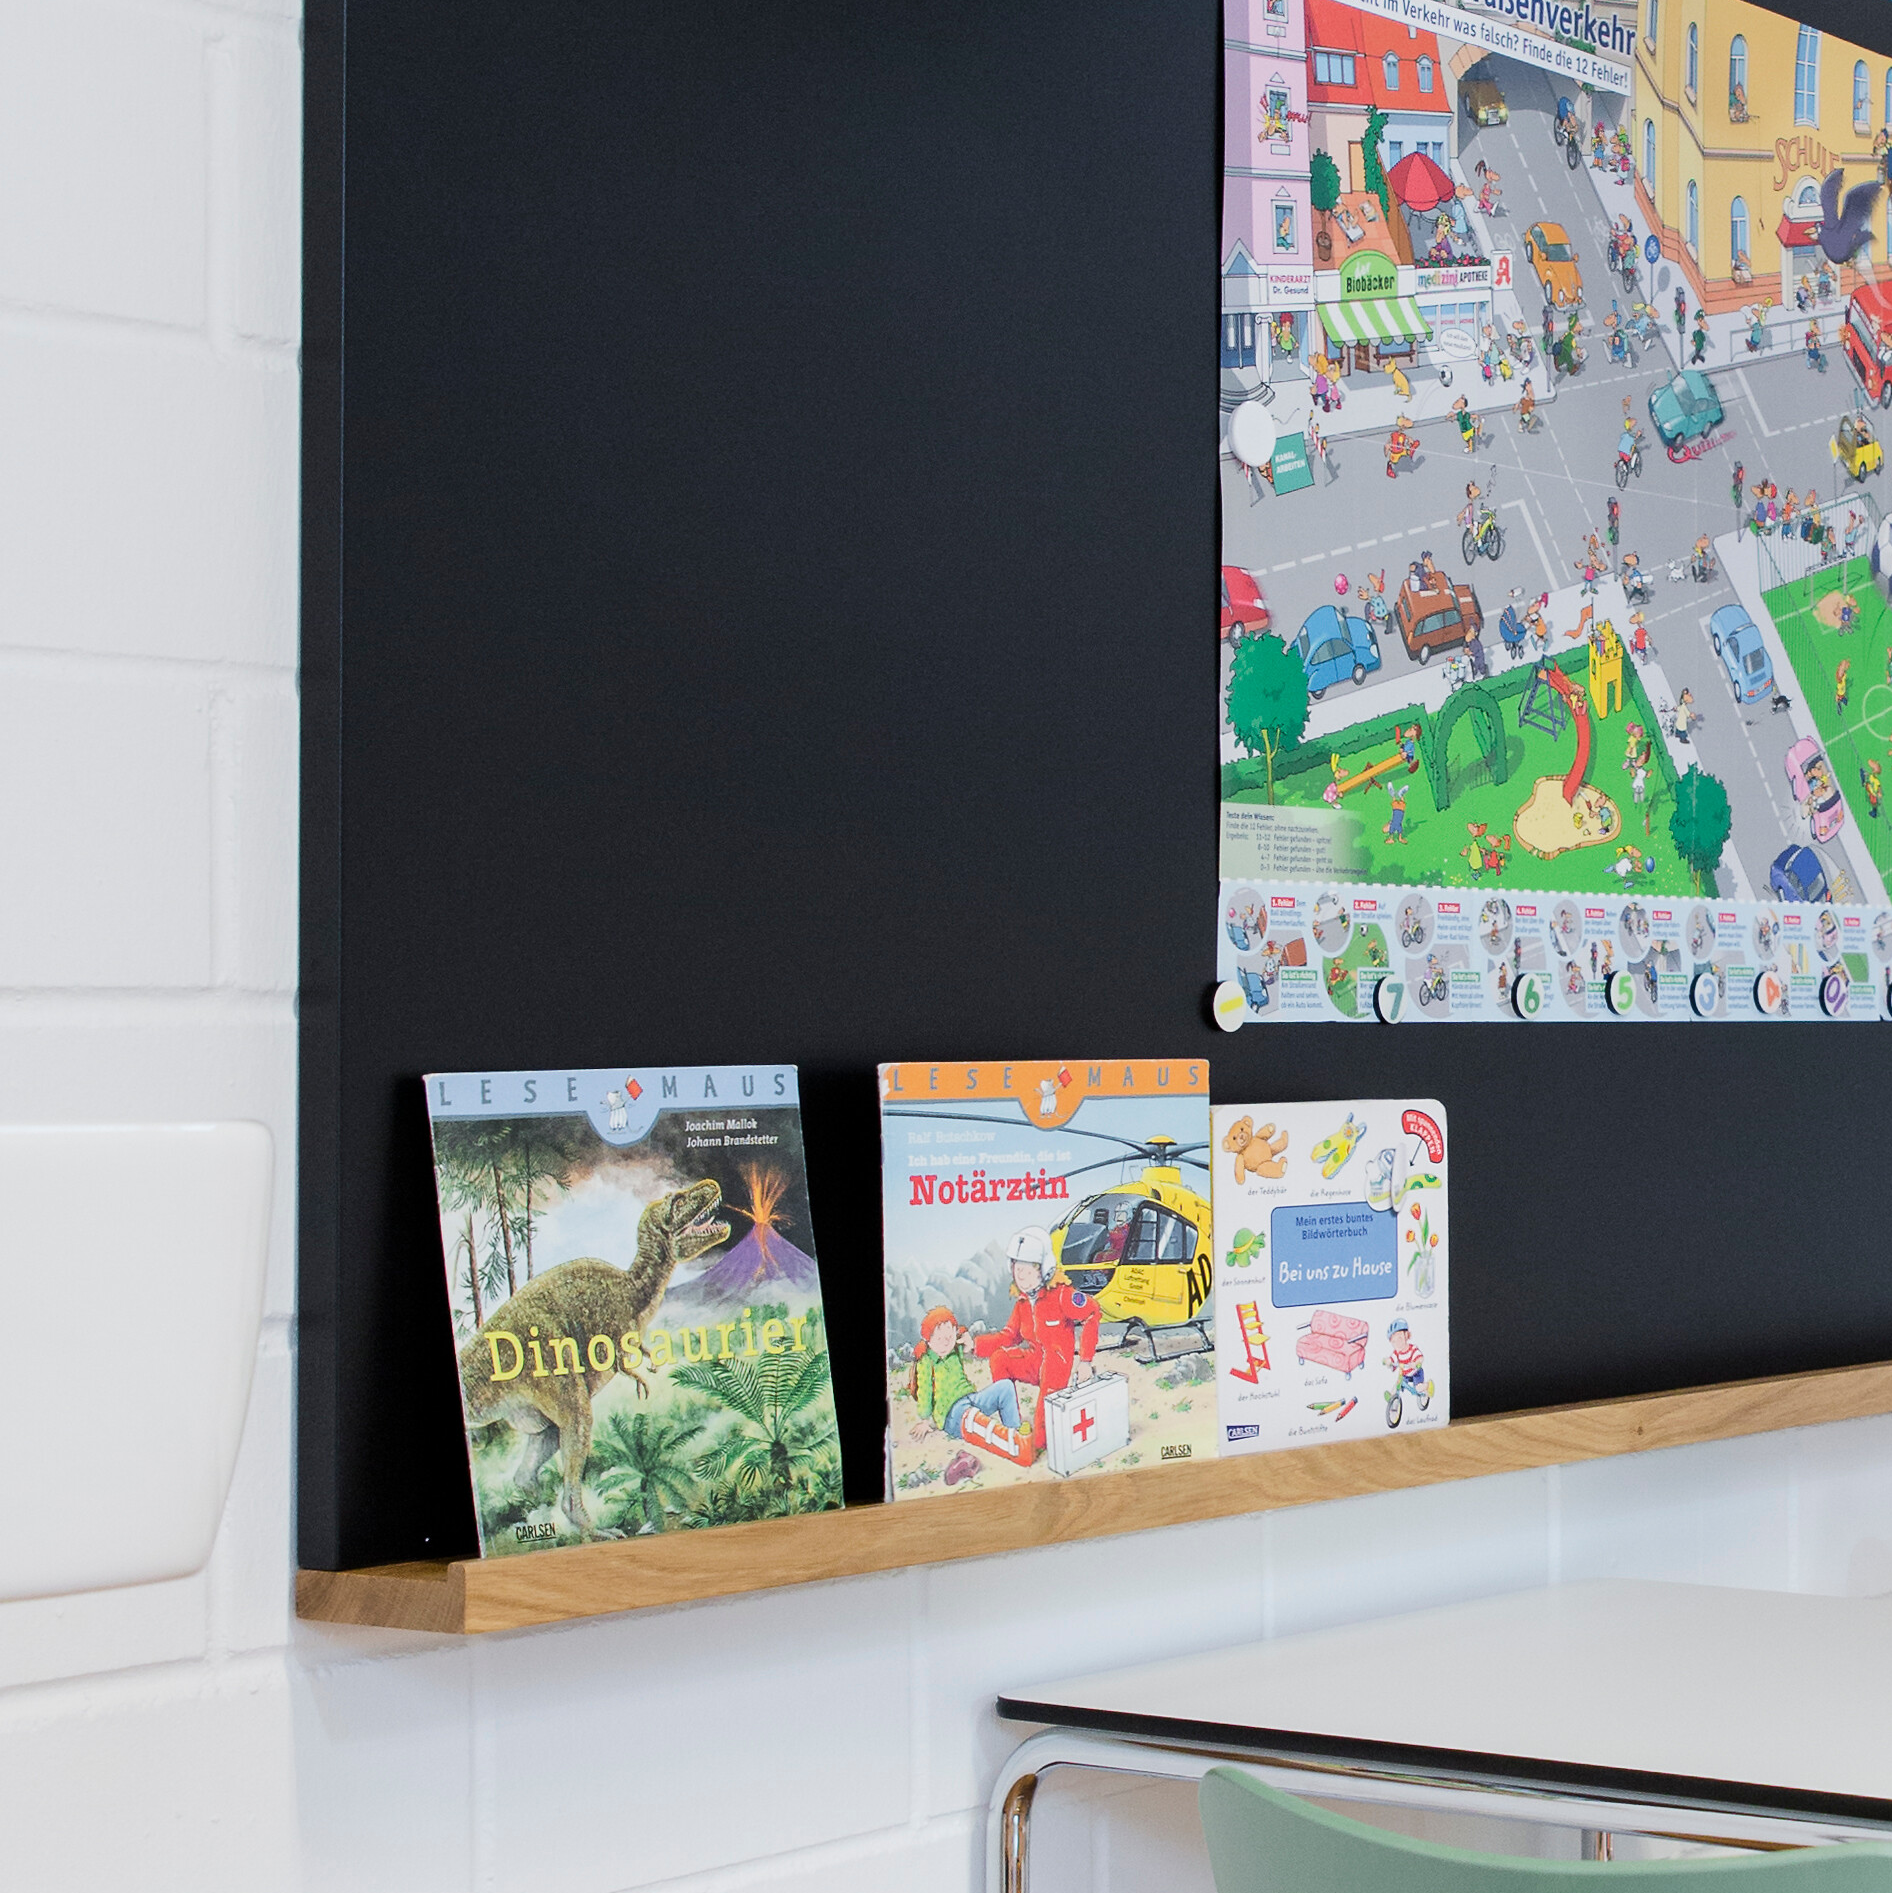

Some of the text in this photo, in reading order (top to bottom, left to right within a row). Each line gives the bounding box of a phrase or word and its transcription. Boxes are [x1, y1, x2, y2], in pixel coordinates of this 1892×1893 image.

[1453, 18, 1476, 37] was
[1481, 22, 1518, 51] falsch?
[1523, 38, 1552, 63] Finde
[1556, 50, 1572, 69] die
[1576, 58, 1587, 75] 12
[1592, 61, 1628, 89] Fehler!
[1270, 275, 1310, 283] KINDERARZT
[1347, 275, 1395, 293] Biobäcker
[1418, 270, 1458, 289] medizini
[1387, 983, 1404, 1020] 7
[1524, 978, 1540, 1013] 6
[1617, 975, 1633, 1010] 5
[1699, 978, 1716, 1011] 3
[685, 1118, 758, 1132] Joachim Mallok
[687, 1134, 779, 1148] Johann Brandstetter
[908, 1130, 997, 1144] Ralf Butschkow
[908, 1150, 1072, 1167] Ich hab eine Freundin, die ist
[909, 1168, 1069, 1205] Notärztin
[1296, 1213, 1373, 1227] Mein erstes buntes
[1302, 1227, 1368, 1240] Bildwörterbuch
[1279, 1256, 1392, 1284] Bei uns zu Hause
[483, 1307, 807, 1382] Dinosaurier
[1228, 1426, 1258, 1438] CARLSEN
[1161, 1444, 1192, 1458] CARLSEN
[516, 1522, 556, 1540] CARLSEN
